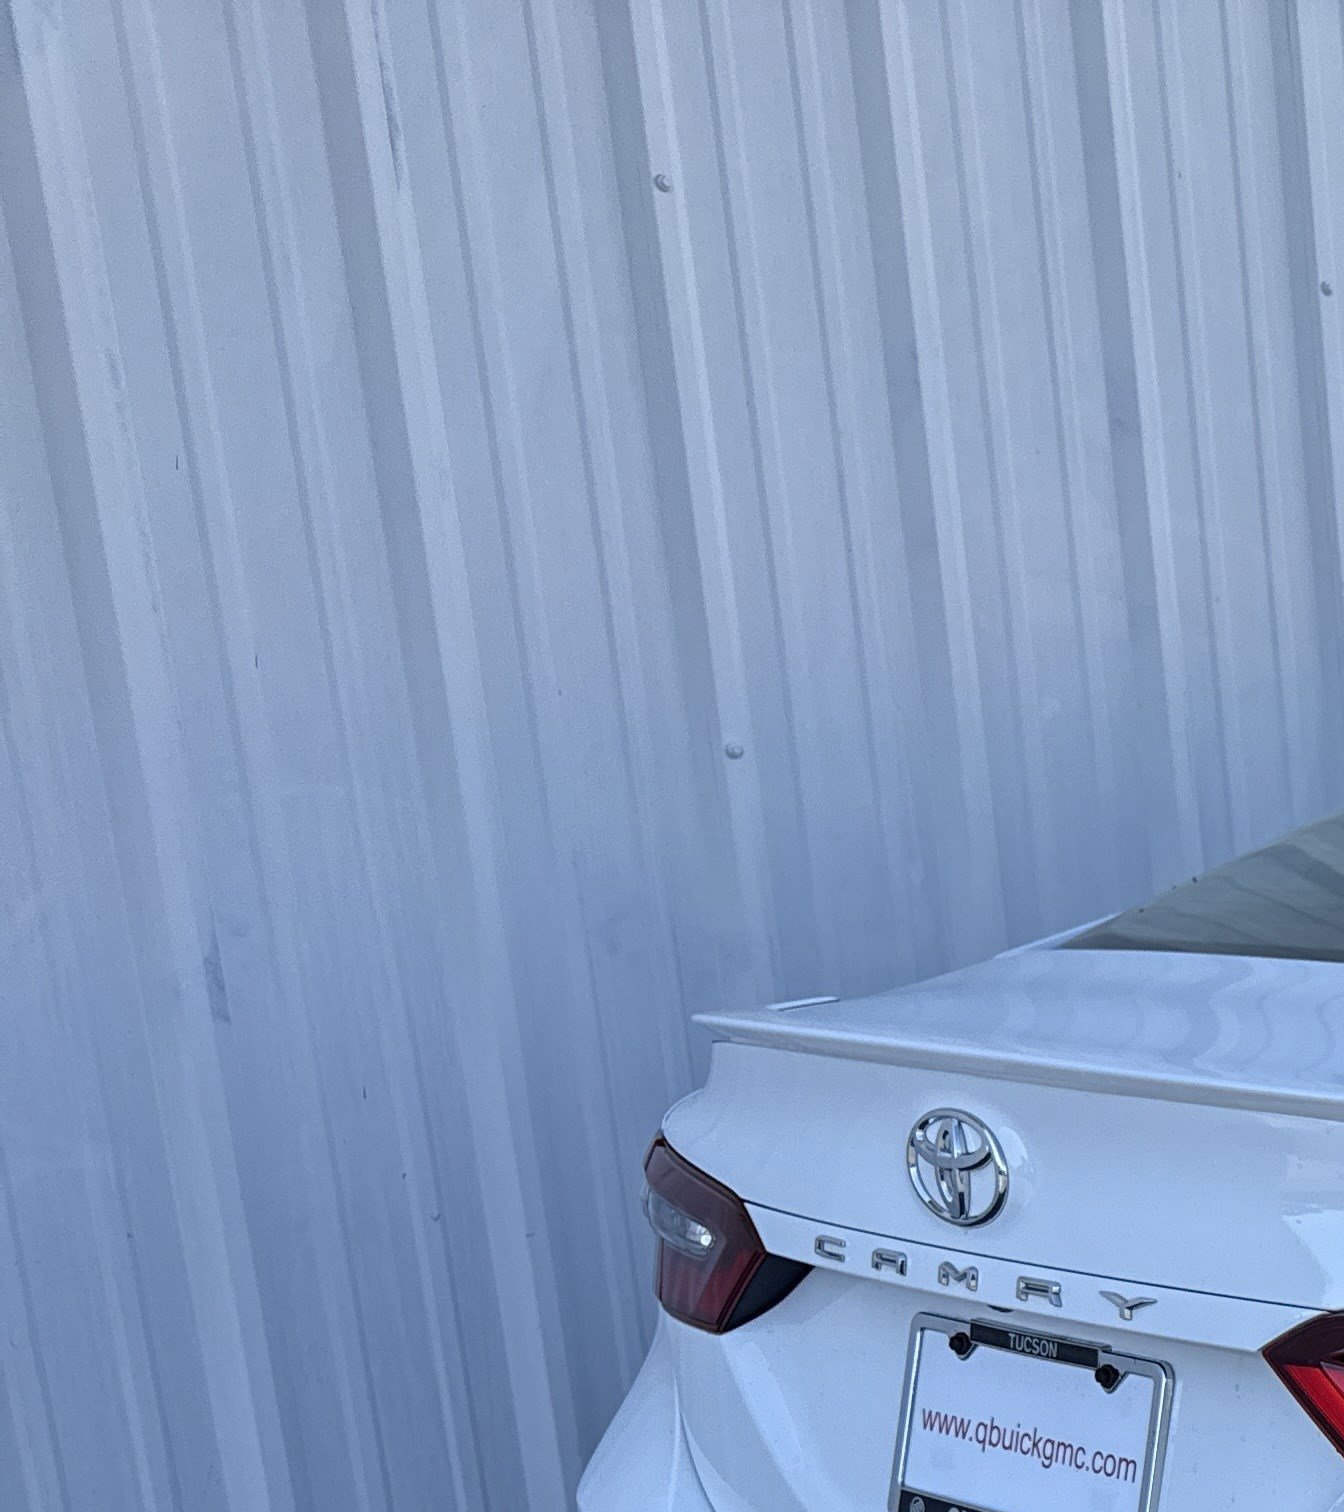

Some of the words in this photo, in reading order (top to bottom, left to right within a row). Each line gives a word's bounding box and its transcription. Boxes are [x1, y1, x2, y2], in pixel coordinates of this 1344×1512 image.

[813, 1234, 1158, 1321] CAMRY
[1007, 1332, 1058, 1358] TUCSON
[921, 1407, 1138, 1484] www.qbuickgmc.com
